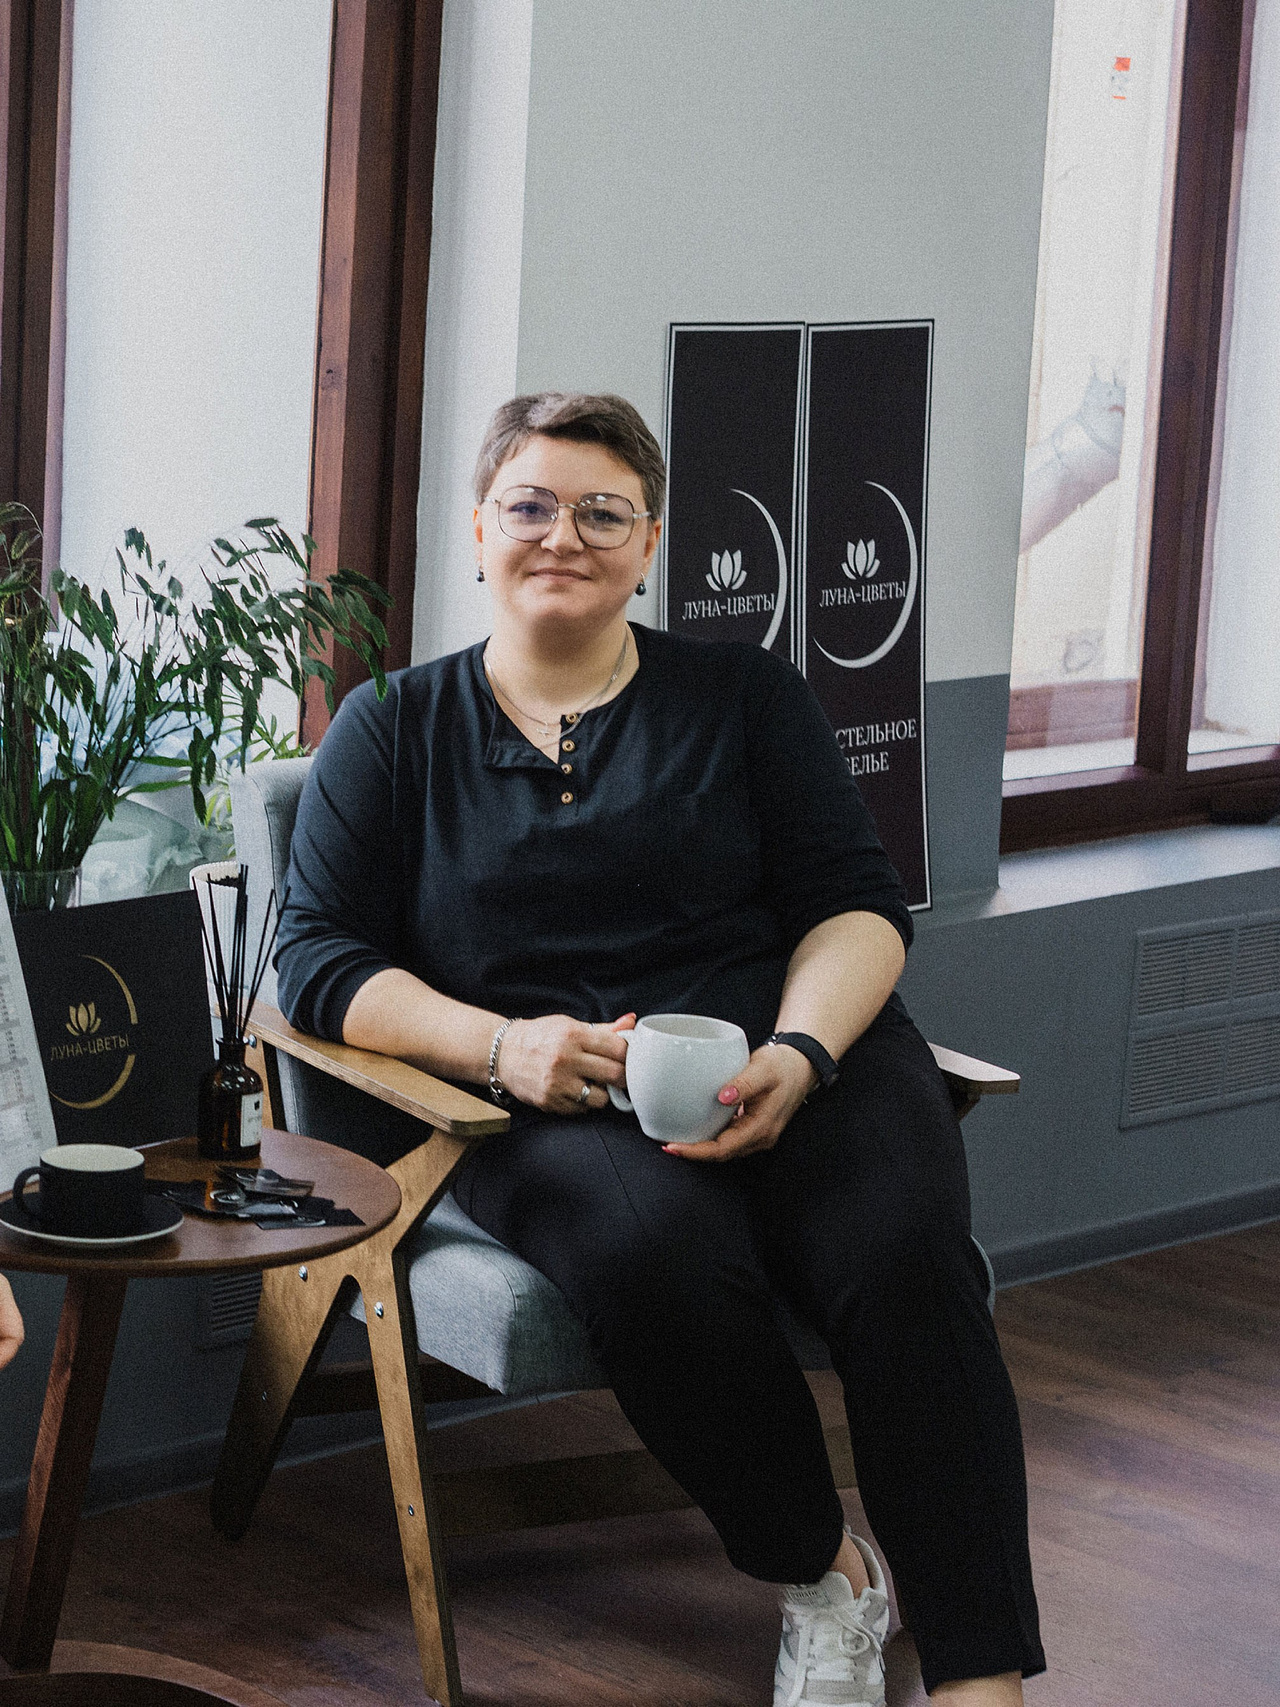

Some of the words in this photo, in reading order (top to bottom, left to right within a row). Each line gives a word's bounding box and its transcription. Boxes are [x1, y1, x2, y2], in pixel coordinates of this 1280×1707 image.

[682, 593, 775, 620] ЛУНА-ЦВЕТЫ
[819, 581, 907, 607] ЛУНА-ЦВЕТЫ
[845, 751, 889, 776] ЕЛЬЕ
[51, 1034, 130, 1061] ЛУНА-ЦВЕТЫ
